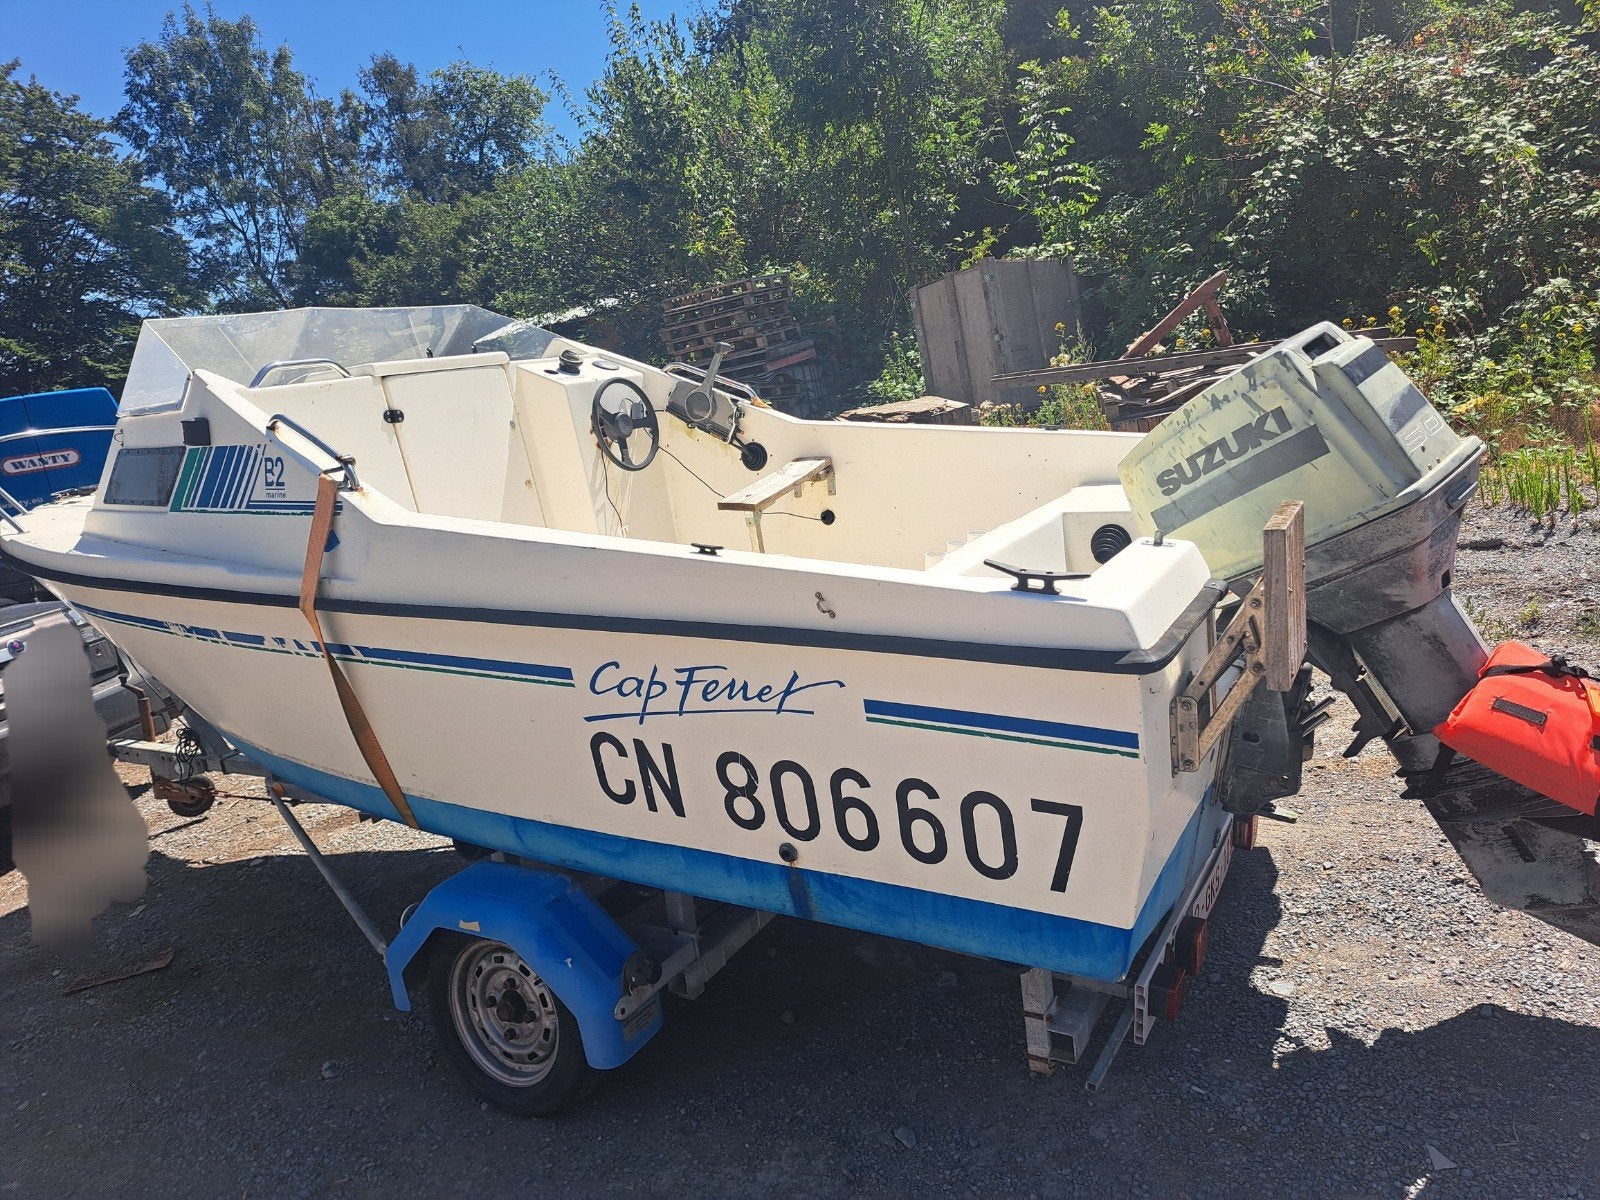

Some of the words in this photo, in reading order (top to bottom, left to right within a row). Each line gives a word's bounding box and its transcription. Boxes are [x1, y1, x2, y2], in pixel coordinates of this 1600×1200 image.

[1156, 406, 1293, 497] SUZUKI
[1399, 412, 1443, 455] 50
[10, 453, 70, 470] WANTY
[264, 456, 285, 487] B2
[265, 490, 287, 498] marine
[589, 660, 668, 725] Cap
[590, 731, 687, 818] CN
[715, 751, 1083, 893] 806607
